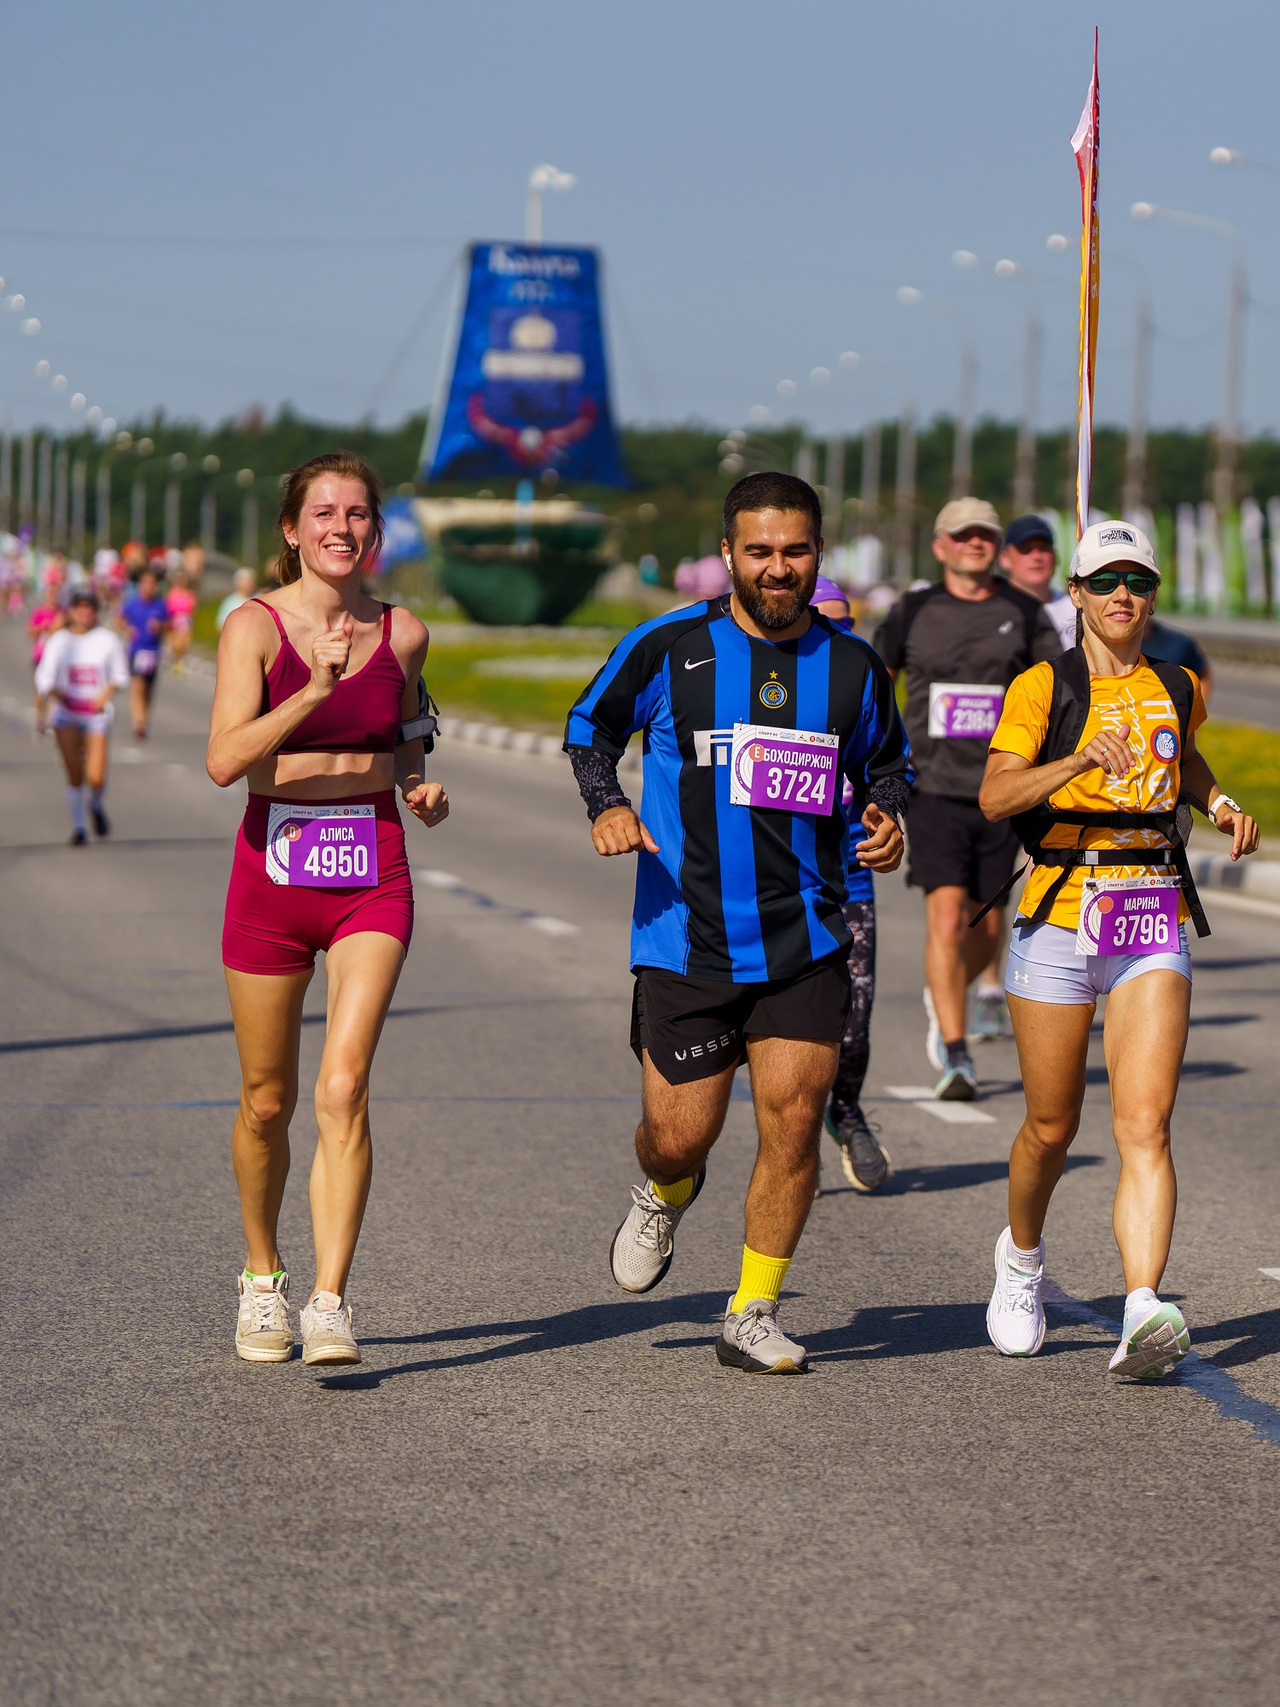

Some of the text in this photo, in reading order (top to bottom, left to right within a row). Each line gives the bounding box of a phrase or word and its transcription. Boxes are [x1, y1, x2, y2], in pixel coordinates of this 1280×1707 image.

[763, 747, 833, 770] БОХОДИРЖОН
[766, 767, 827, 805] 3724
[289, 826, 296, 838] D
[319, 827, 355, 842] АЛИСА
[304, 845, 368, 877] 4950
[1123, 896, 1160, 912] МАРИНА
[1113, 913, 1169, 947] 3796
